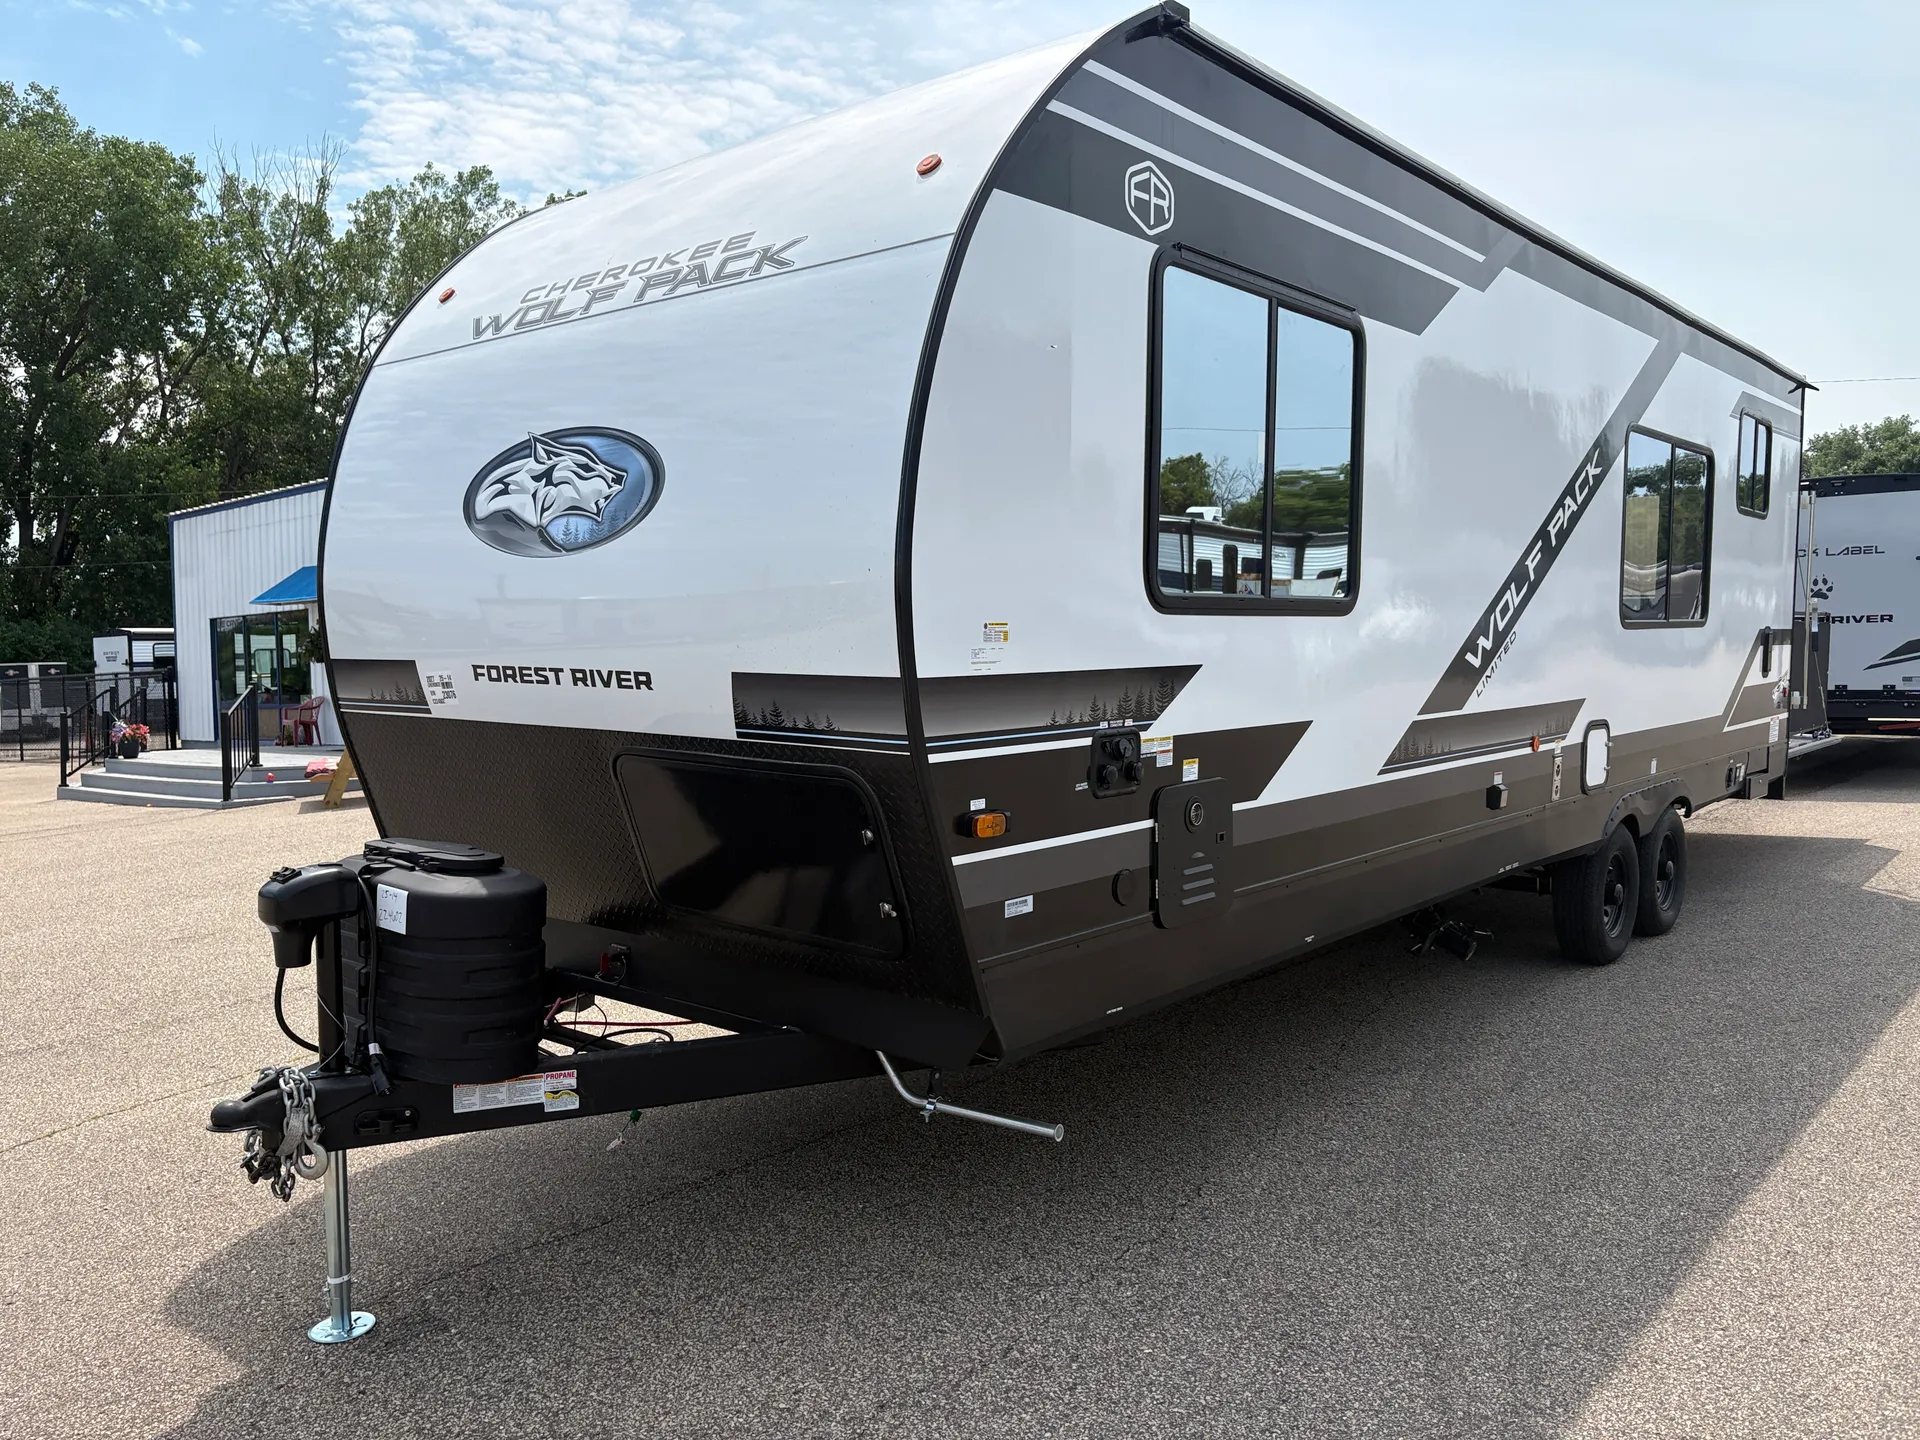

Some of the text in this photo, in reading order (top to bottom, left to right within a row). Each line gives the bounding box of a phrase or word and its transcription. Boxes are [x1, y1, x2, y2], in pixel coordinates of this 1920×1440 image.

[472, 233, 809, 340] WOLF PACK
[519, 230, 757, 304] CHEROKEE
[1464, 447, 1603, 669] WOLF PACK
[1825, 545, 1885, 557] LABEL
[1831, 614, 1894, 624] RIVER
[471, 664, 654, 691] FOREST RIVER
[1475, 630, 1517, 698] LIMITED
[545, 1070, 576, 1080] PROPANE
